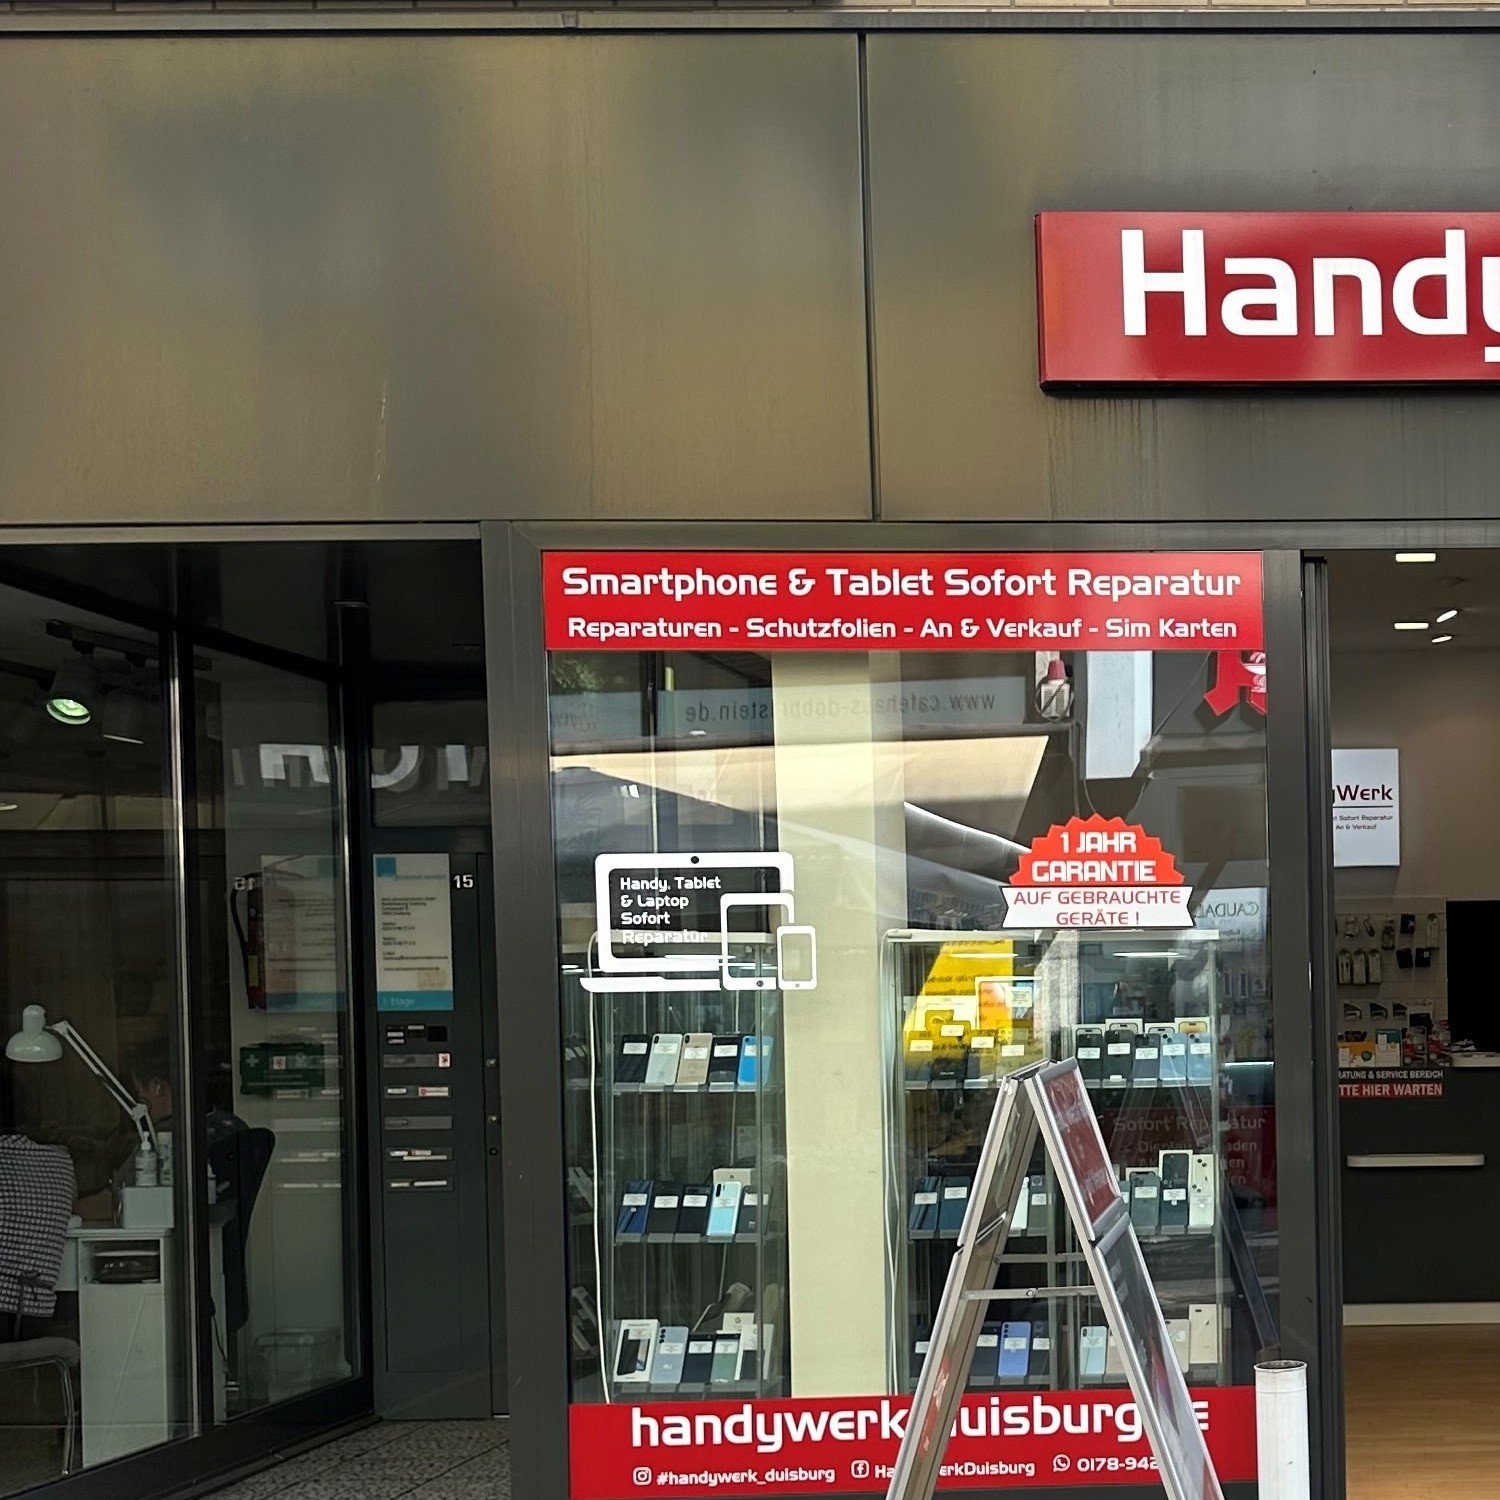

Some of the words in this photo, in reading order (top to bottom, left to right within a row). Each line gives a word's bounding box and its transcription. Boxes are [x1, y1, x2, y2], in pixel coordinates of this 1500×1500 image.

[562, 567, 778, 602] Smartphone
[788, 568, 816, 597] &
[825, 568, 934, 597] Tablet
[944, 568, 1057, 597] Sofort
[1067, 568, 1241, 602] Reparatur
[568, 616, 722, 642] Reparaturen
[746, 617, 897, 639] Schutzfolien
[920, 618, 953, 639] An
[960, 618, 980, 639] &
[986, 617, 1083, 639] Verkauf
[1105, 617, 1151, 639] Sim
[1159, 618, 1237, 639] Karten
[1332, 784, 1393, 804] Werk
[1059, 831, 1070, 854] 1
[1075, 831, 1137, 854] JAHR
[1031, 860, 1157, 883] GARANTIE
[453, 874, 474, 889] 15
[674, 875, 722, 889] Tablet
[620, 895, 634, 907] &
[637, 894, 690, 909] Laptop
[1013, 891, 1053, 906] AUF
[1057, 890, 1182, 905] GEBRAUCHTE
[621, 912, 671, 925] Sofort
[1056, 908, 1129, 926] GERÄTE
[622, 929, 708, 946] Reparatur
[1338, 1083, 1360, 1096] TTE
[1362, 1083, 1390, 1096] HIER
[1392, 1083, 1443, 1096] WARTEN
[656, 1467, 836, 1487] #handywerk_duisburg
[875, 1461, 1036, 1479] HaerkDuisburg
[1077, 1456, 1160, 1472] 0178-942
